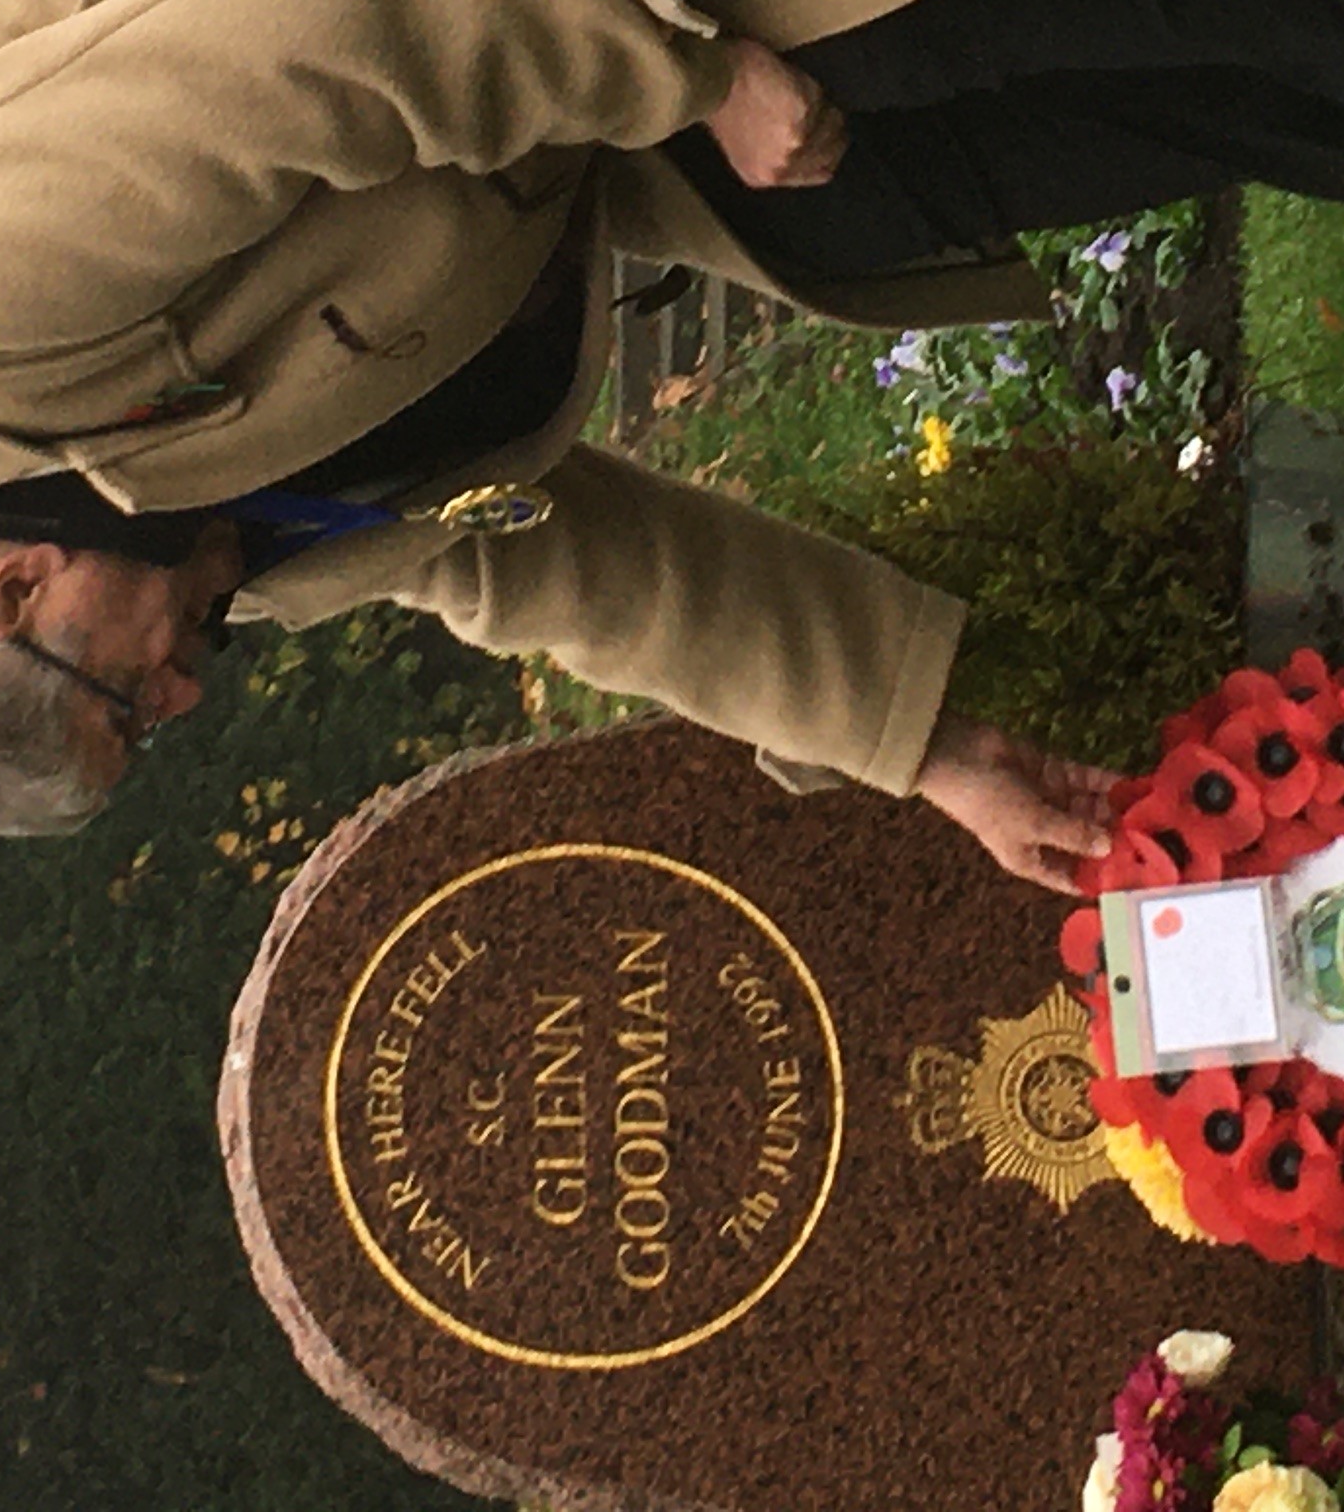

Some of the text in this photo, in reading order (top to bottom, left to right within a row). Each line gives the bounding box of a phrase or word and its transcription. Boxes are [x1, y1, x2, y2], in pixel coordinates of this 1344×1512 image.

[365, 930, 491, 1290] NEAR HERE FELL
[531, 990, 588, 1225] GLENN
[614, 928, 670, 1289] GOODMAN
[718, 952, 806, 1252] 7th JUNE 1992
